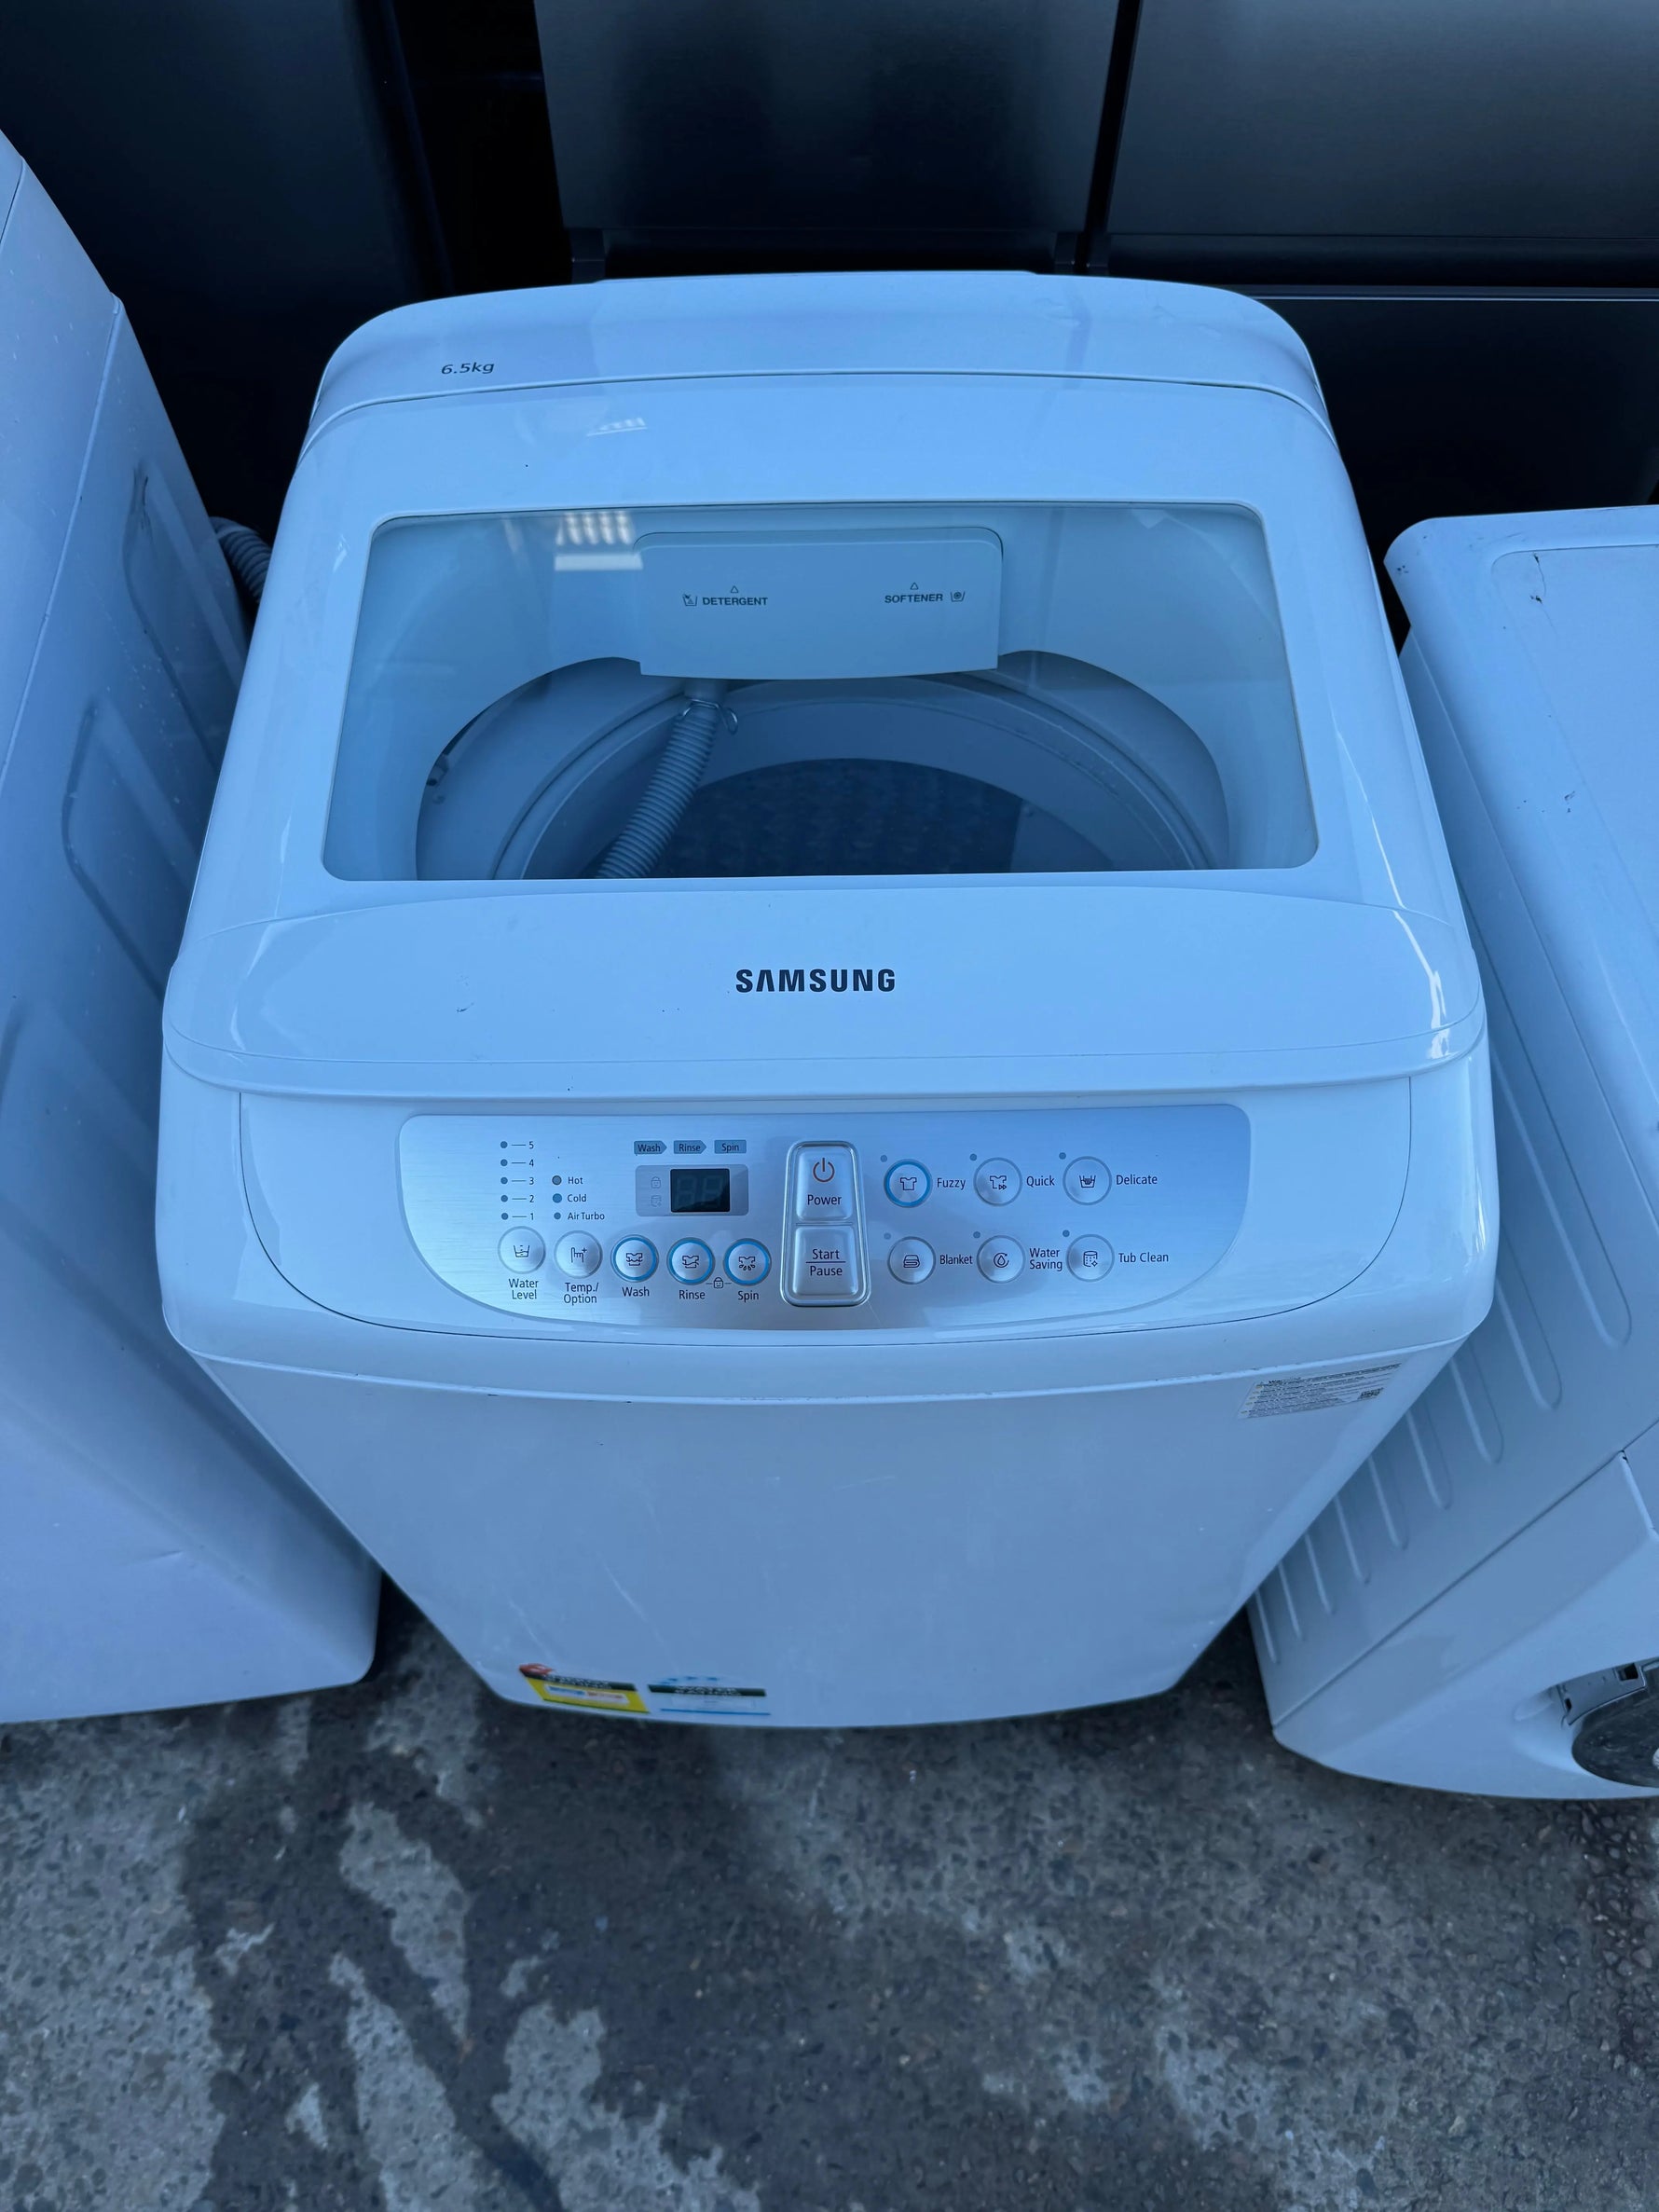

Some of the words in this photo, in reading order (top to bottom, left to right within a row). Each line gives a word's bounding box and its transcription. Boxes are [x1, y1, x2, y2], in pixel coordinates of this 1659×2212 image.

[441, 362, 495, 375] 6.5kg
[702, 597, 768, 606] DETERGENT
[884, 593, 943, 604] SOFTENER
[735, 969, 895, 994] SAMSUNG
[528, 1140, 535, 1150] 5
[638, 1143, 661, 1154] Wash
[679, 1142, 702, 1153] Rinse
[721, 1142, 740, 1154] Spin
[528, 1158, 535, 1168] 4
[528, 1176, 535, 1186] 3
[568, 1175, 583, 1185] Hot
[937, 1177, 967, 1190] Fuzzy
[1026, 1175, 1055, 1187] Quick
[1116, 1174, 1158, 1186] Delicate
[528, 1194, 535, 1203] 2
[567, 1193, 587, 1202] Cold
[807, 1193, 842, 1206] Power
[529, 1212, 534, 1221] 1
[568, 1212, 580, 1220] Air
[582, 1212, 605, 1220] Turbo
[812, 1249, 840, 1260] Start
[1029, 1247, 1060, 1258] Water
[1118, 1252, 1137, 1263] Tub
[1140, 1251, 1169, 1263] Clean
[939, 1254, 973, 1266] Blanket
[1029, 1258, 1063, 1271] Saving
[810, 1266, 843, 1277] Pause
[509, 1278, 539, 1289] Water
[565, 1283, 598, 1294] Temp./
[512, 1290, 537, 1300] Level
[623, 1286, 650, 1298] Wash
[679, 1289, 706, 1301] Rinse
[737, 1290, 760, 1302] Spin
[563, 1293, 597, 1305] Option
